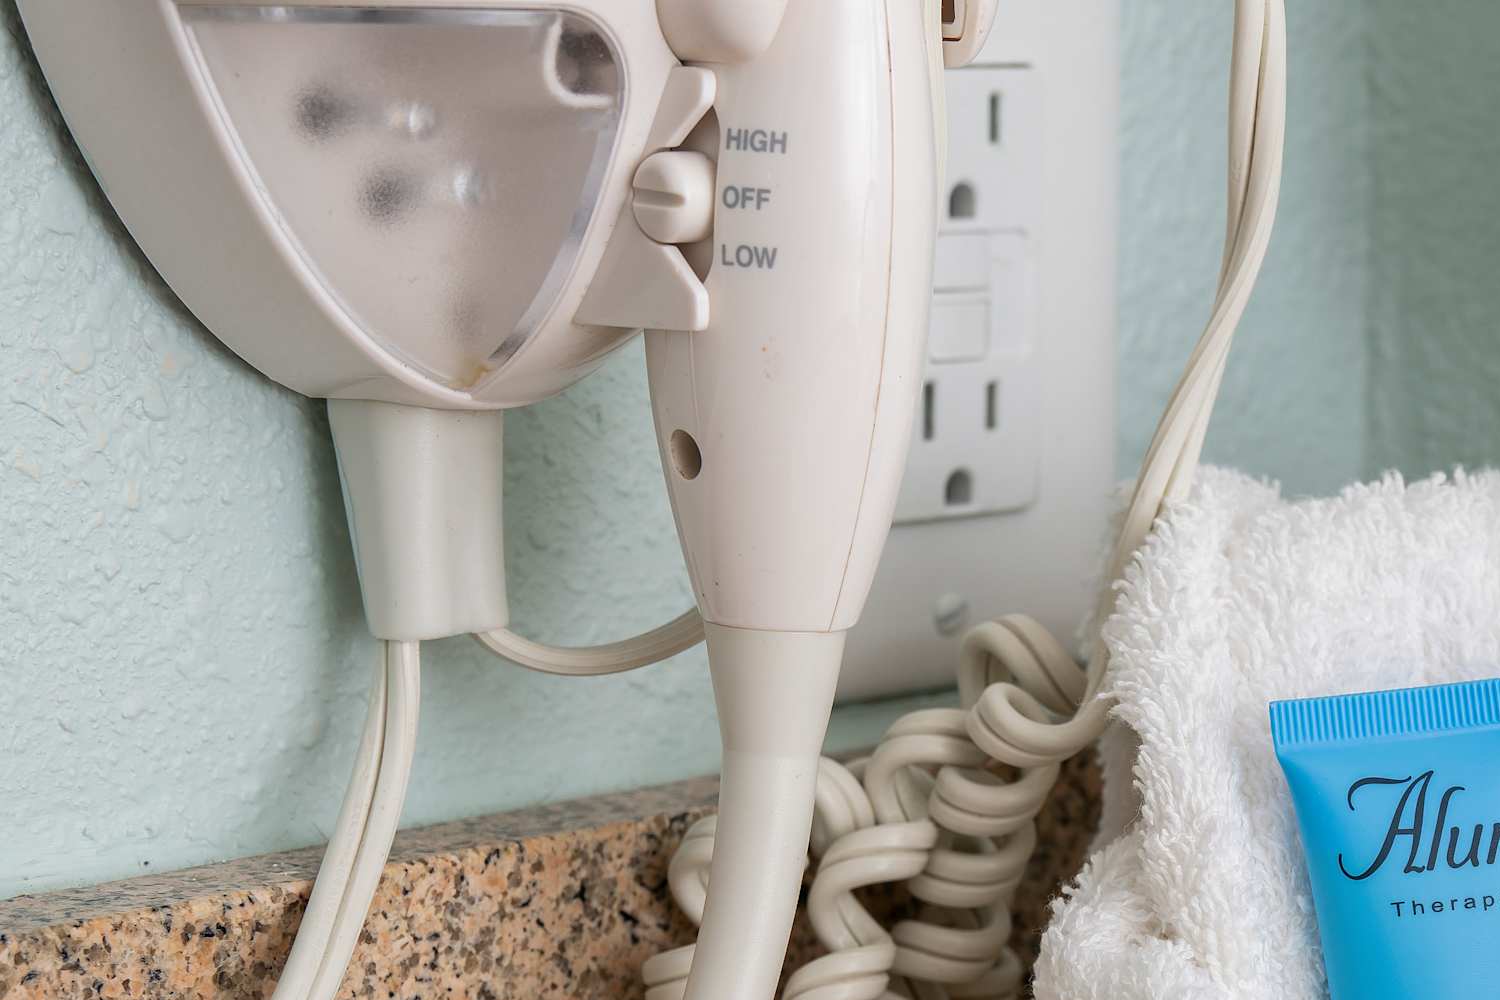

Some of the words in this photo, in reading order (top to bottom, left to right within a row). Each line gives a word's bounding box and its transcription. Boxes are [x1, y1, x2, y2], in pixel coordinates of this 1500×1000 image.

[725, 128, 788, 154] HIGH
[722, 186, 772, 210] OFF
[720, 244, 778, 270] LOW
